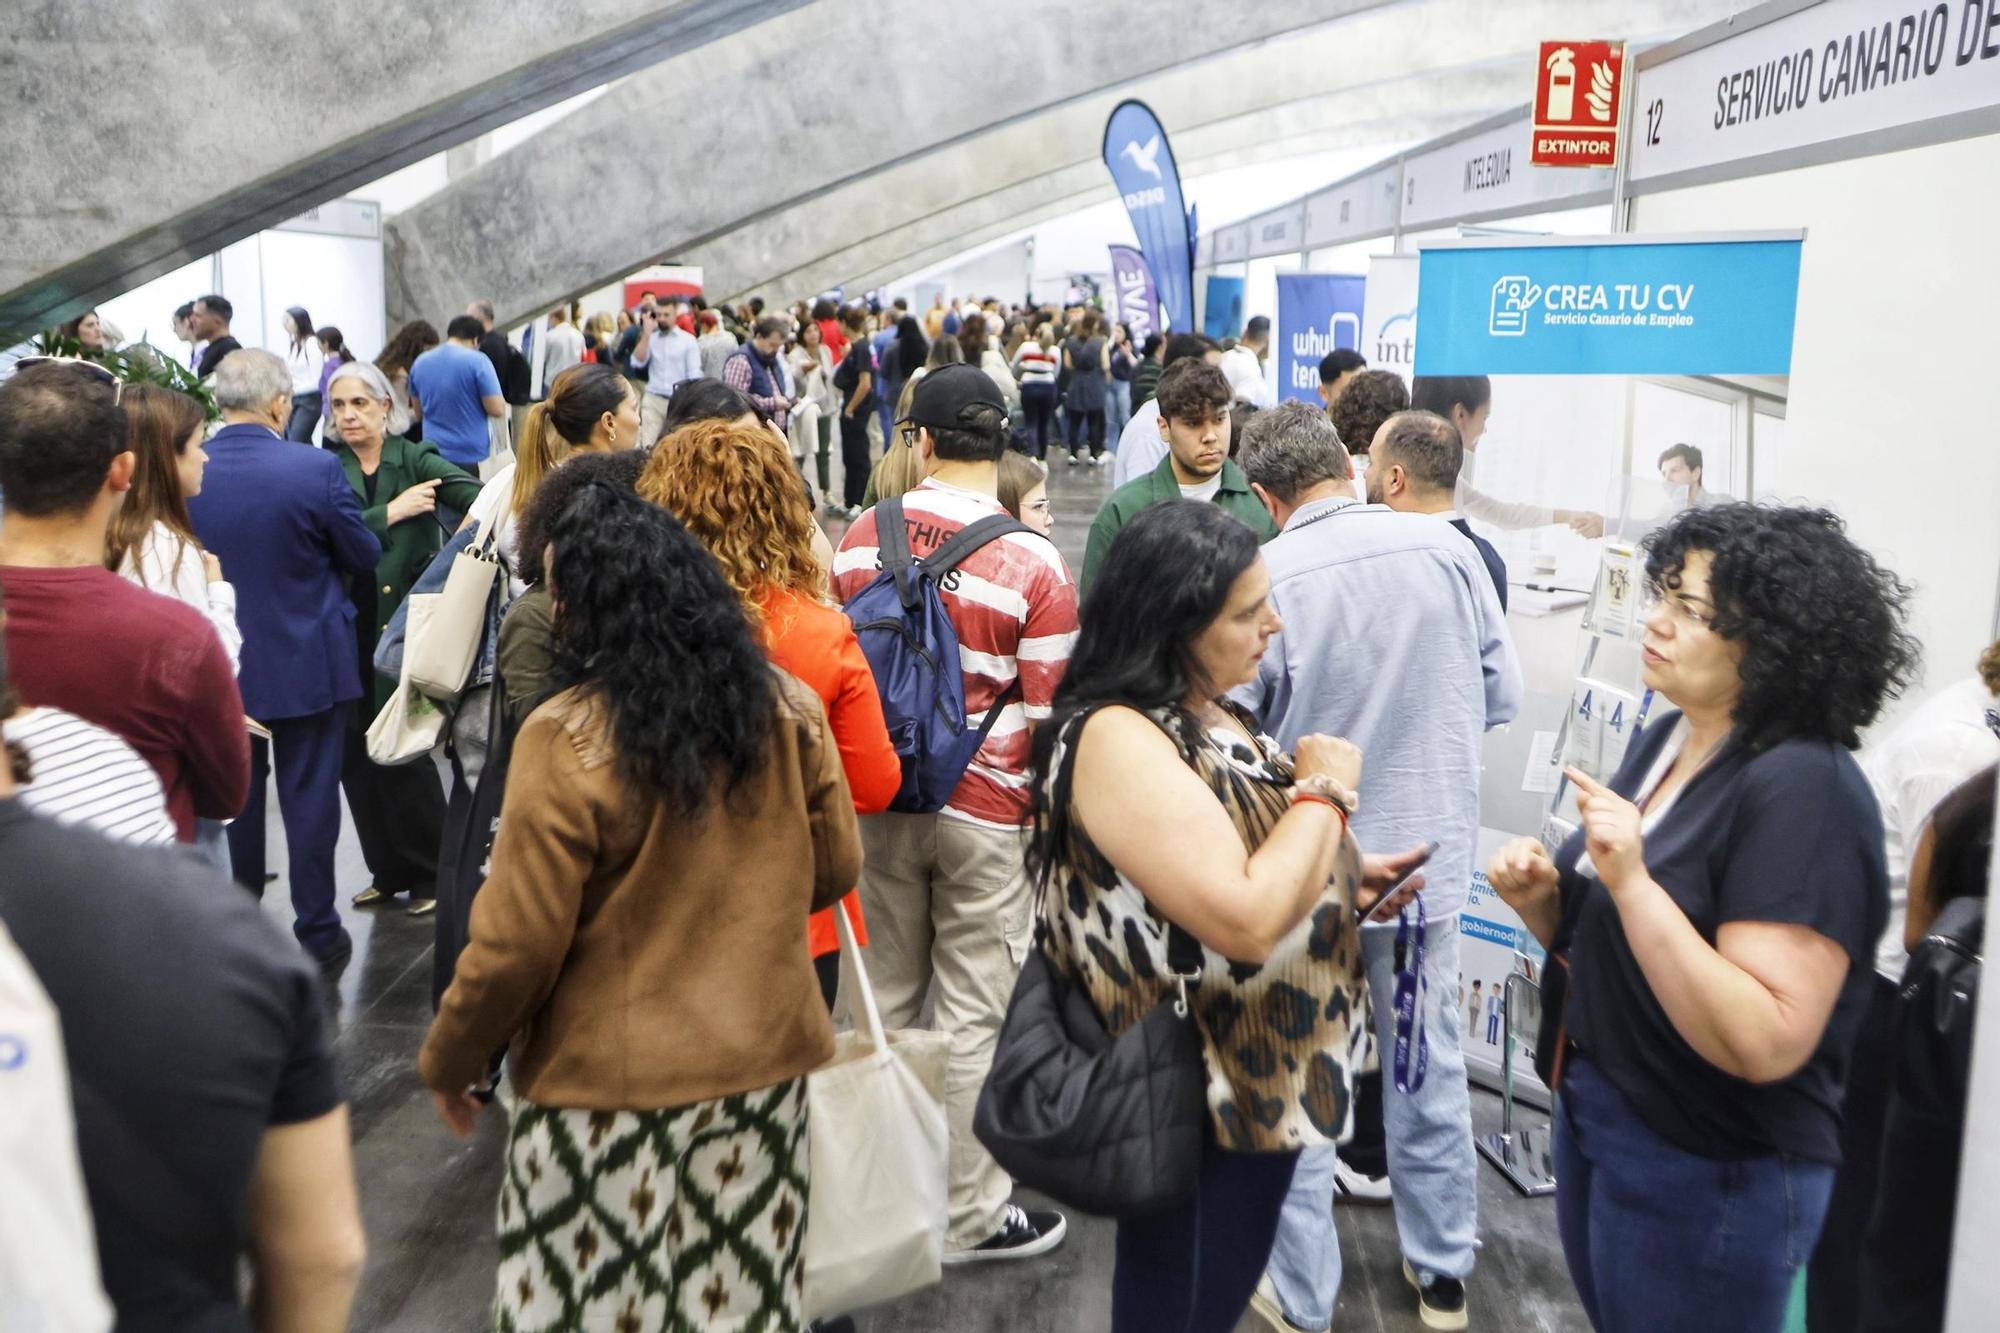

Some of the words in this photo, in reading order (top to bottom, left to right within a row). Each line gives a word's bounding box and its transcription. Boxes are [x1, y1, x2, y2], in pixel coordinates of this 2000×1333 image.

[1714, 48, 1813, 130] SERVICIO
[1818, 3, 1948, 103] CANARIO
[1956, 0, 2000, 67] DE
[1647, 98, 1663, 147] 12
[1538, 139, 1610, 154] EXTINTOR
[1463, 147, 1511, 192] INTELEQUIA
[1544, 284, 1609, 311] CREA
[1615, 284, 1650, 311] TU
[1657, 284, 1694, 311] CV
[1544, 312, 1587, 325] Servicio
[1589, 312, 1631, 326] Canario
[1633, 312, 1647, 325] de
[1649, 313, 1694, 328] Empleo
